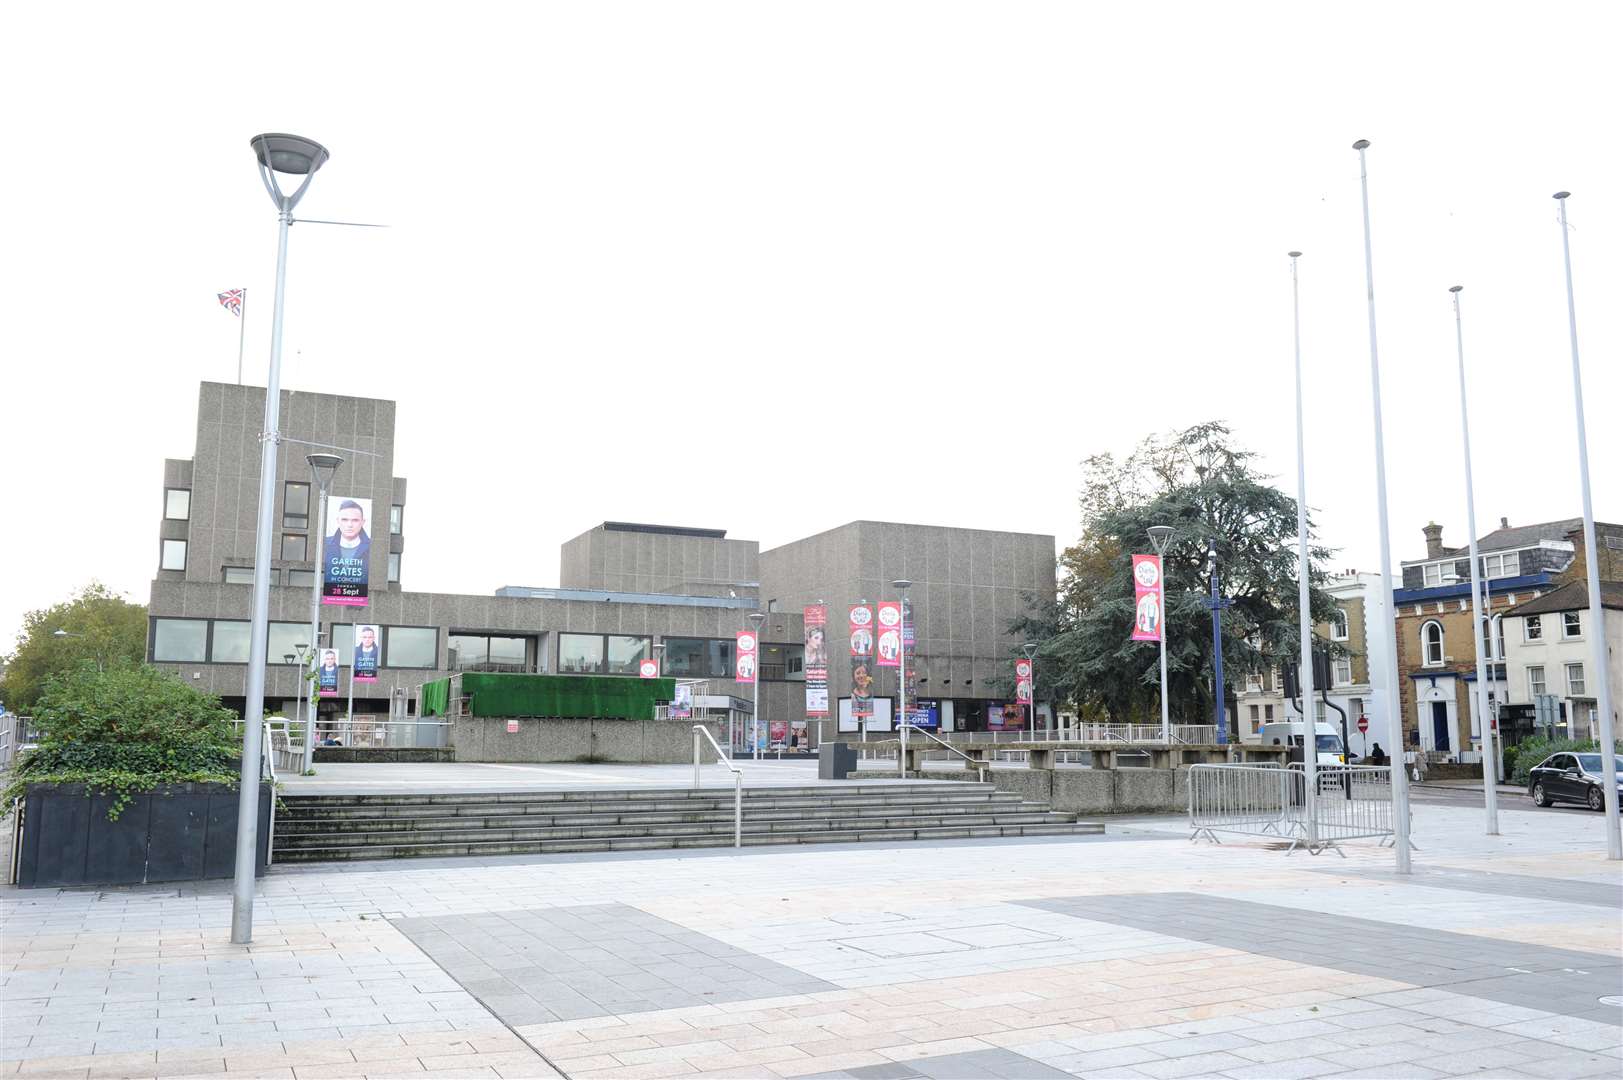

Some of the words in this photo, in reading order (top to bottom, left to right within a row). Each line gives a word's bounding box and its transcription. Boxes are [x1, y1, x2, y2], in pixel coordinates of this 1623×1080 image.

[331, 557, 363, 566] GARETH
[331, 566, 363, 577] GATES
[343, 588, 359, 597] Sept
